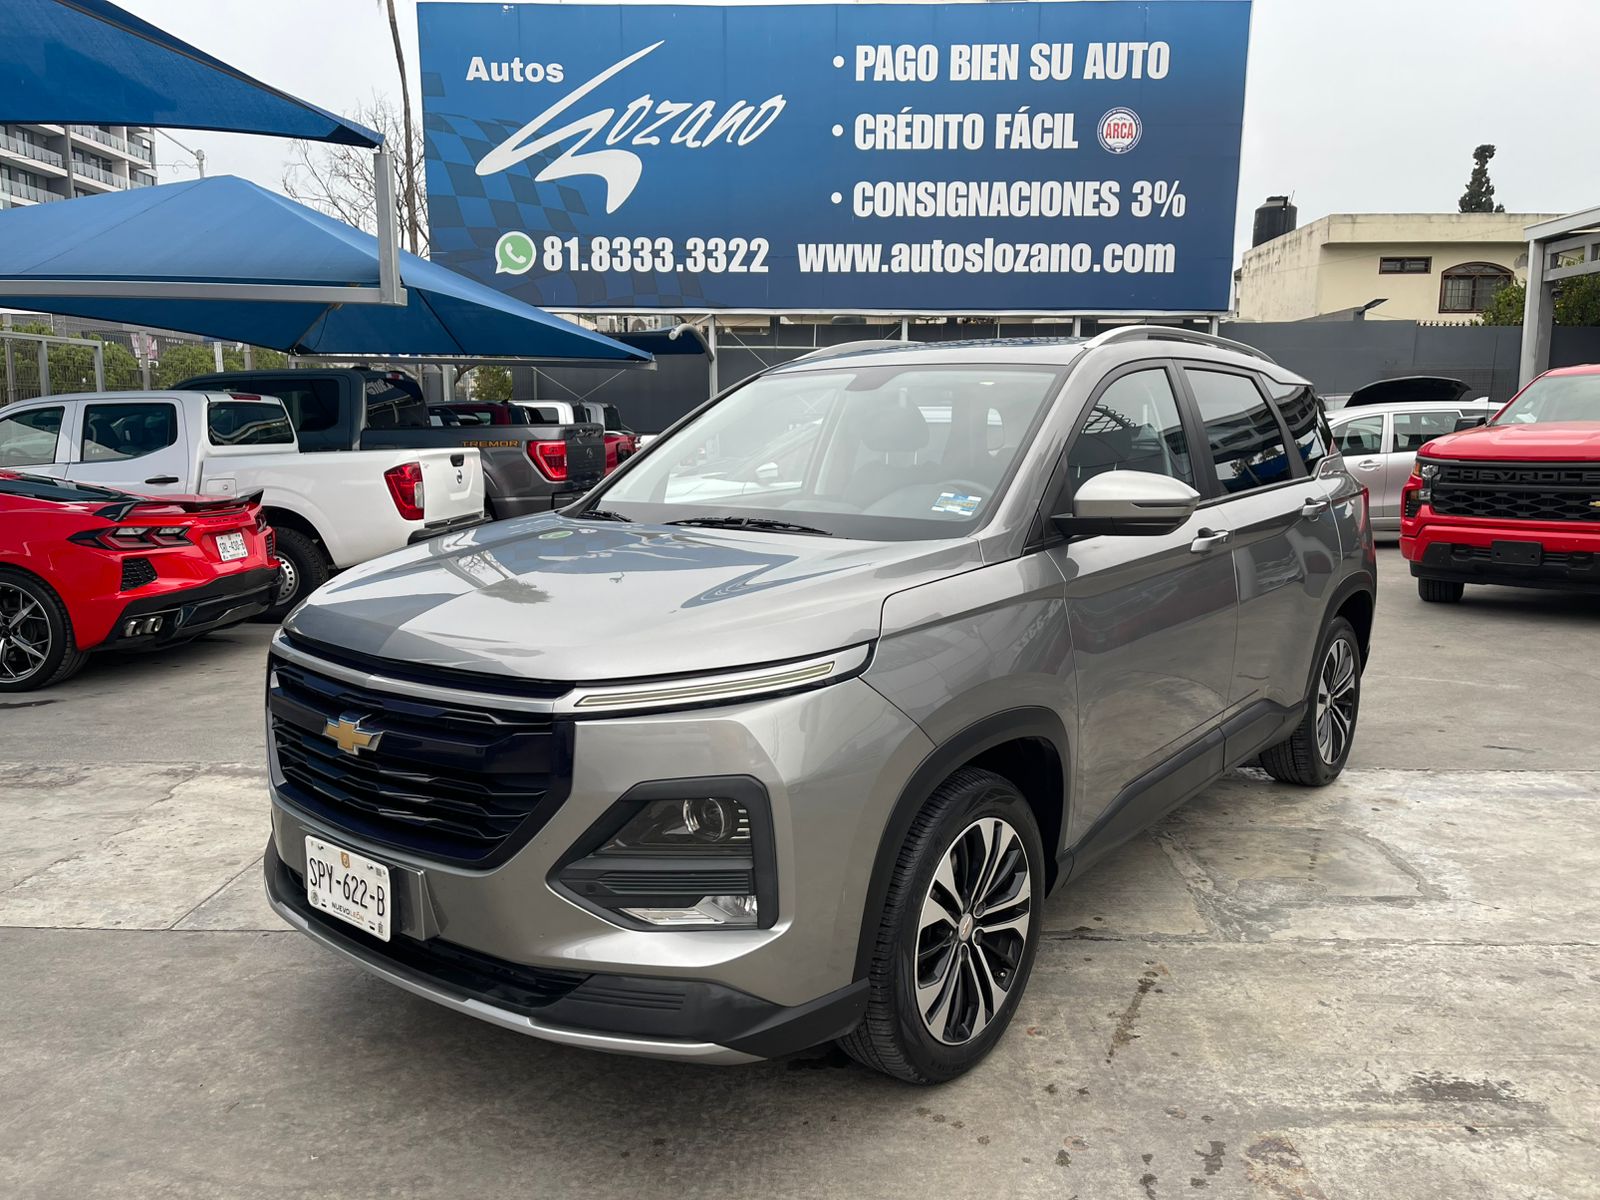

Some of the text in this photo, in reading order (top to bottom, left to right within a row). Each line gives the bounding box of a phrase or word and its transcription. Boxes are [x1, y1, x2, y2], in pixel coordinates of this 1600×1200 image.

[466, 56, 564, 83] Autos
[856, 41, 1170, 82] PAGO BIEN SU AUTO
[475, 40, 787, 214] Lozano
[854, 105, 1079, 151] CRÉDITO FÁCIL
[1105, 122, 1134, 139] ARCA
[853, 180, 1186, 218] CONSIGNACIONES 3%
[543, 236, 1176, 274] 81.8333.3322 www.autoslozano.com
[463, 440, 519, 448] TREMOR
[309, 857, 385, 917] SPY-622-B
